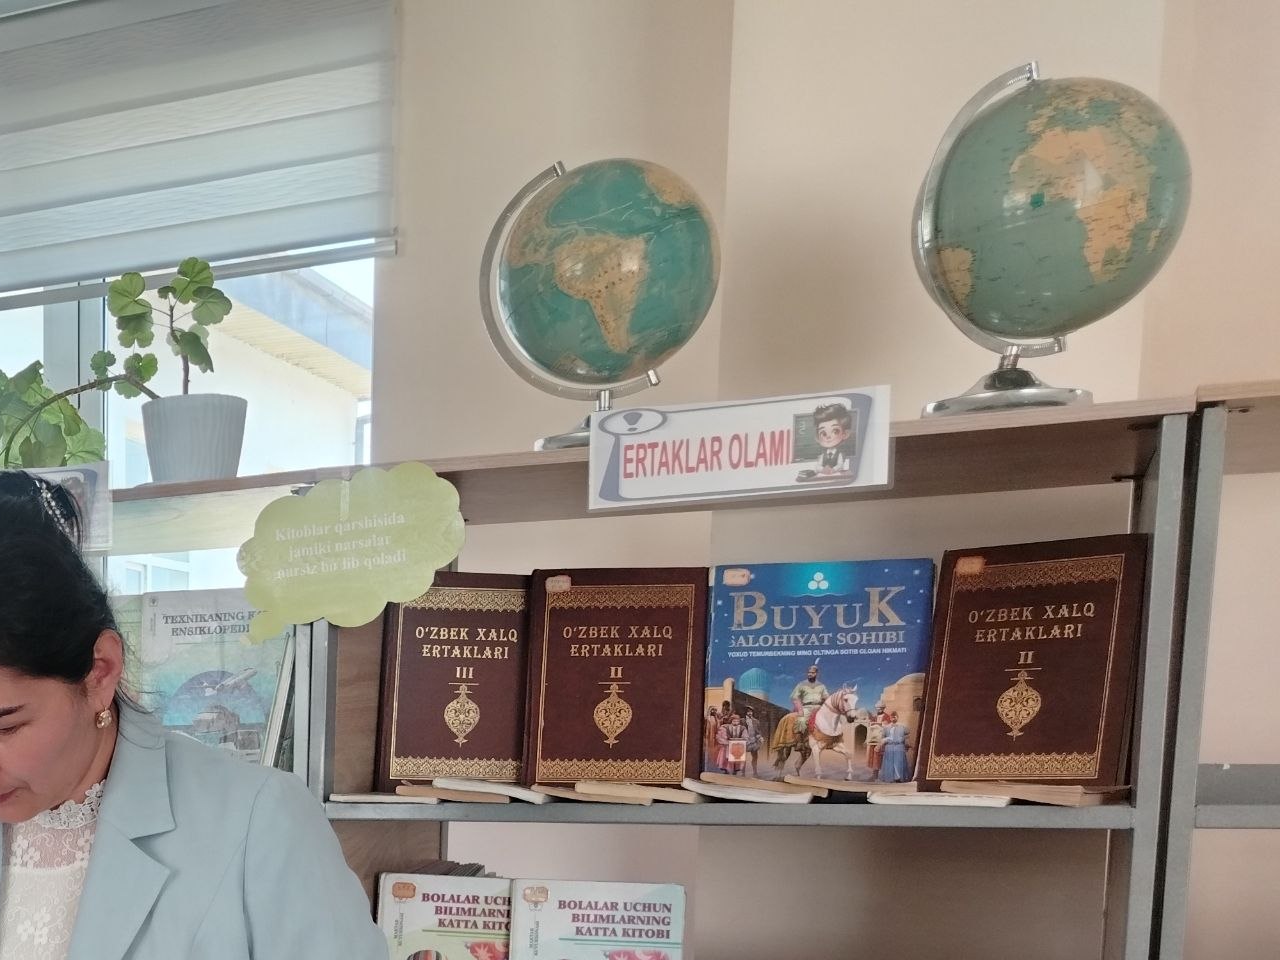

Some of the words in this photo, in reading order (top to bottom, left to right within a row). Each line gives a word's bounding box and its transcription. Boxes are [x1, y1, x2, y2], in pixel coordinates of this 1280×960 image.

[623, 436, 722, 479] ERTAKLAR
[729, 429, 792, 470] OLAMI
[275, 525, 330, 541] Kitoblar
[335, 512, 406, 535] qarshisida
[289, 542, 331, 562] jamiki
[335, 535, 392, 553] narsalar
[728, 586, 907, 631] BUYUK
[968, 606, 1034, 624] O'ZBEK
[1042, 602, 1096, 619] XALQ
[163, 611, 244, 625] TEXNIKANING
[415, 626, 469, 641] O'ZBEK
[475, 628, 519, 642] XALQ
[562, 625, 620, 639] O'ZBEK
[627, 625, 673, 639] XALQ
[836, 630, 905, 645] SOHIBI
[975, 623, 1082, 643] ERTAKLARI
[421, 644, 509, 659] ERTAKLARI
[570, 644, 663, 657] ERTAKLARI
[1018, 651, 1035, 665] II
[455, 667, 474, 679] III
[609, 666, 623, 679] II
[421, 892, 480, 906] BOLALAR
[558, 899, 616, 912] BOLALAR
[618, 901, 672, 913] UCHUN
[437, 918, 478, 930] KATTA
[570, 913, 671, 926] BILIMLARNING
[575, 925, 619, 937] KATTA
[621, 927, 671, 939] KITOBI
